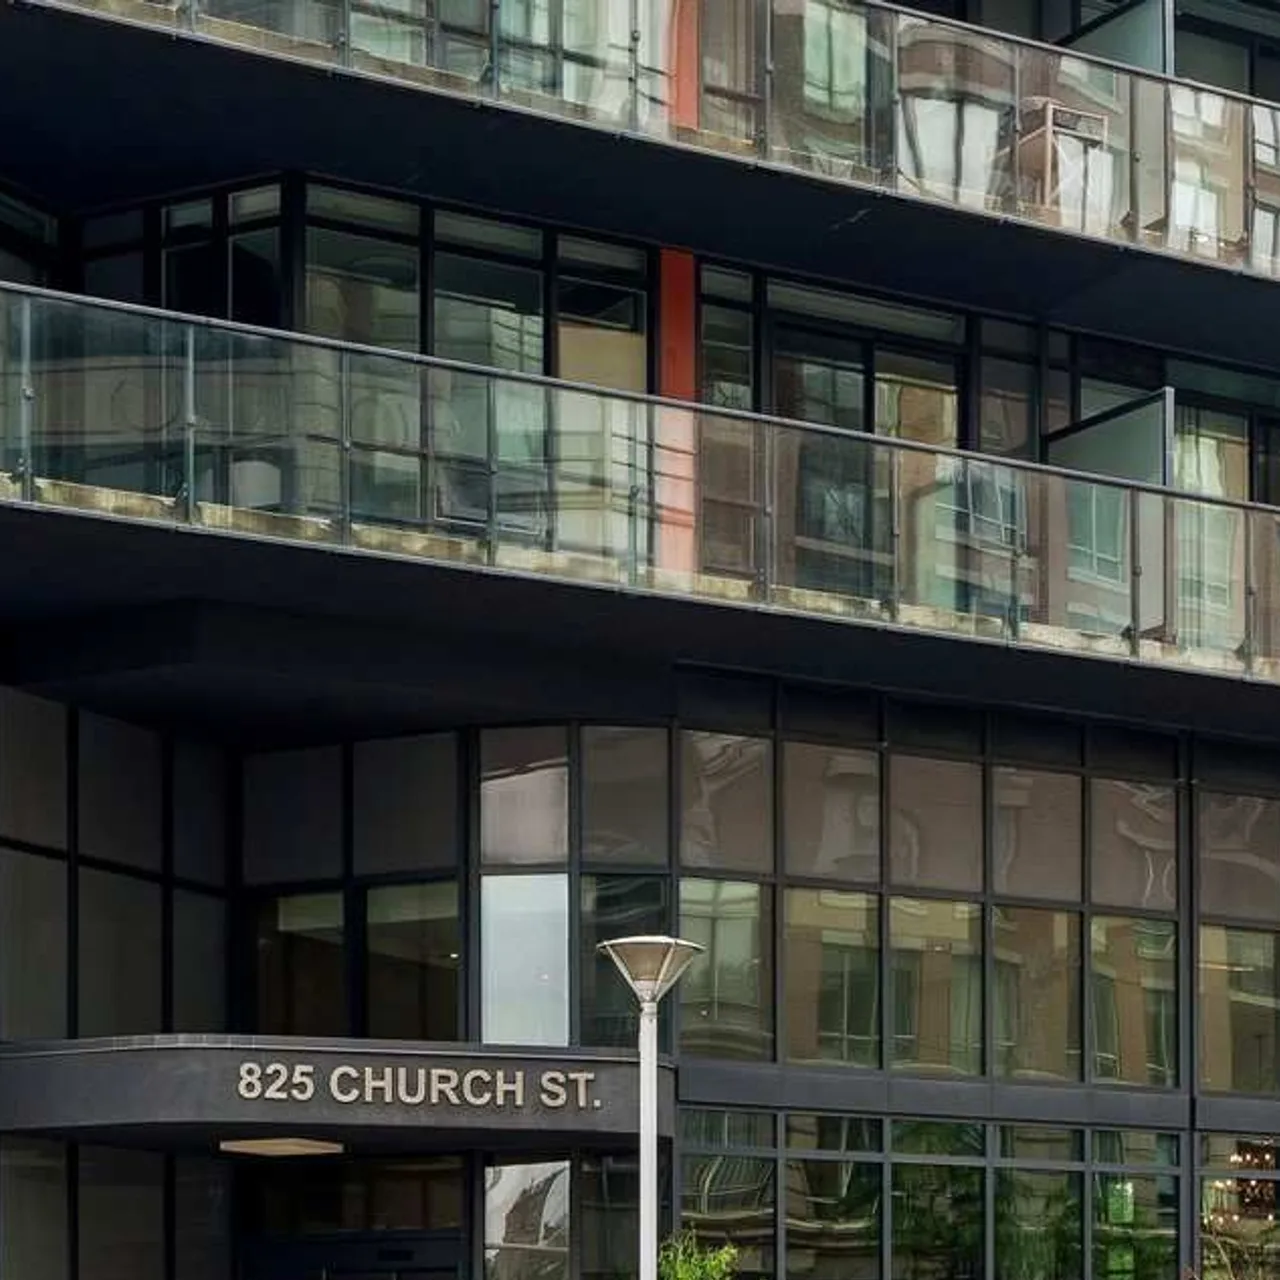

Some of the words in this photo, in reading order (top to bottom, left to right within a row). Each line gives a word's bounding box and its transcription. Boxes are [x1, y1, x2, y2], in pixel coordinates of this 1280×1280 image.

[237, 1062, 315, 1100] 825
[329, 1065, 524, 1107] CHURCH
[540, 1071, 602, 1108] ST.
